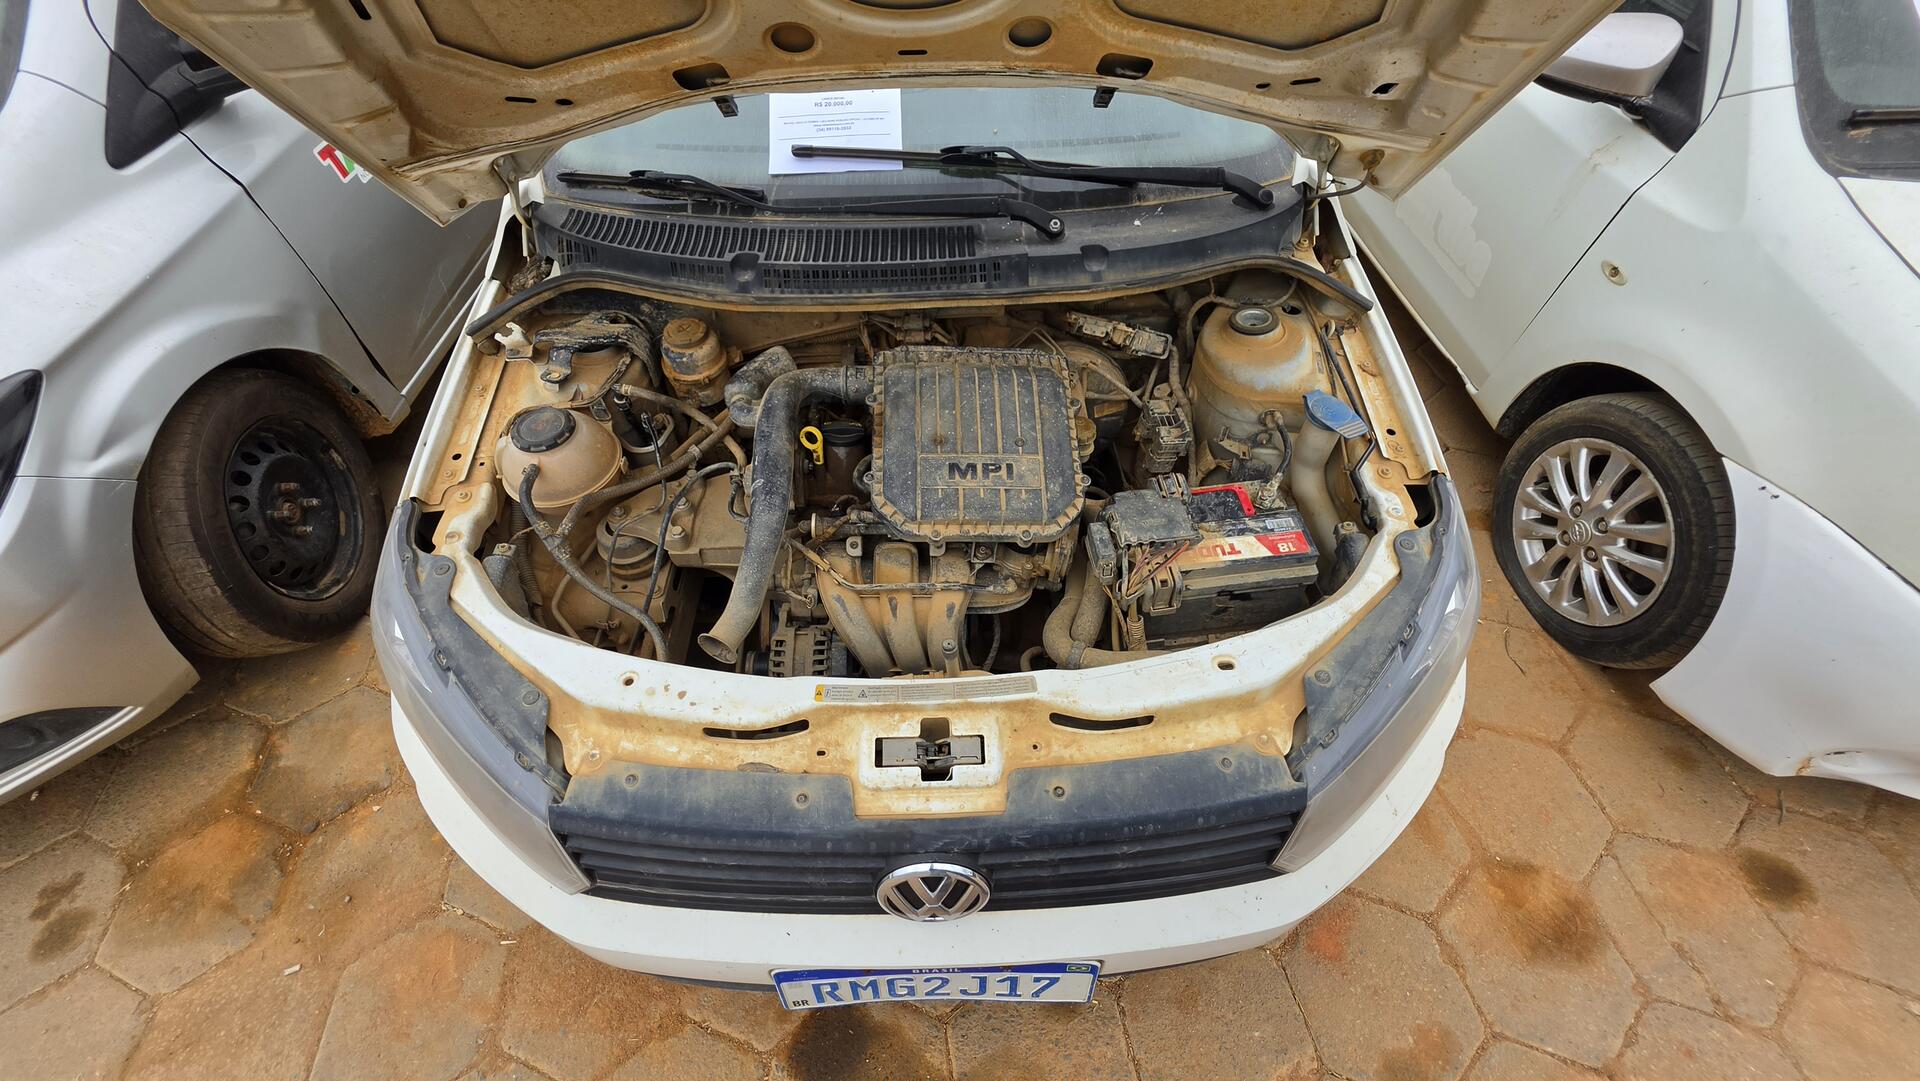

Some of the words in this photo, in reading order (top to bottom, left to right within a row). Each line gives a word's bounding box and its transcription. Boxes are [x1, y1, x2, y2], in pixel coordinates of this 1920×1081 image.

[948, 462, 1014, 482] MPI
[1278, 542, 1297, 553] 18
[811, 976, 1060, 1003] RMG2J17
[792, 999, 810, 1008] BR
